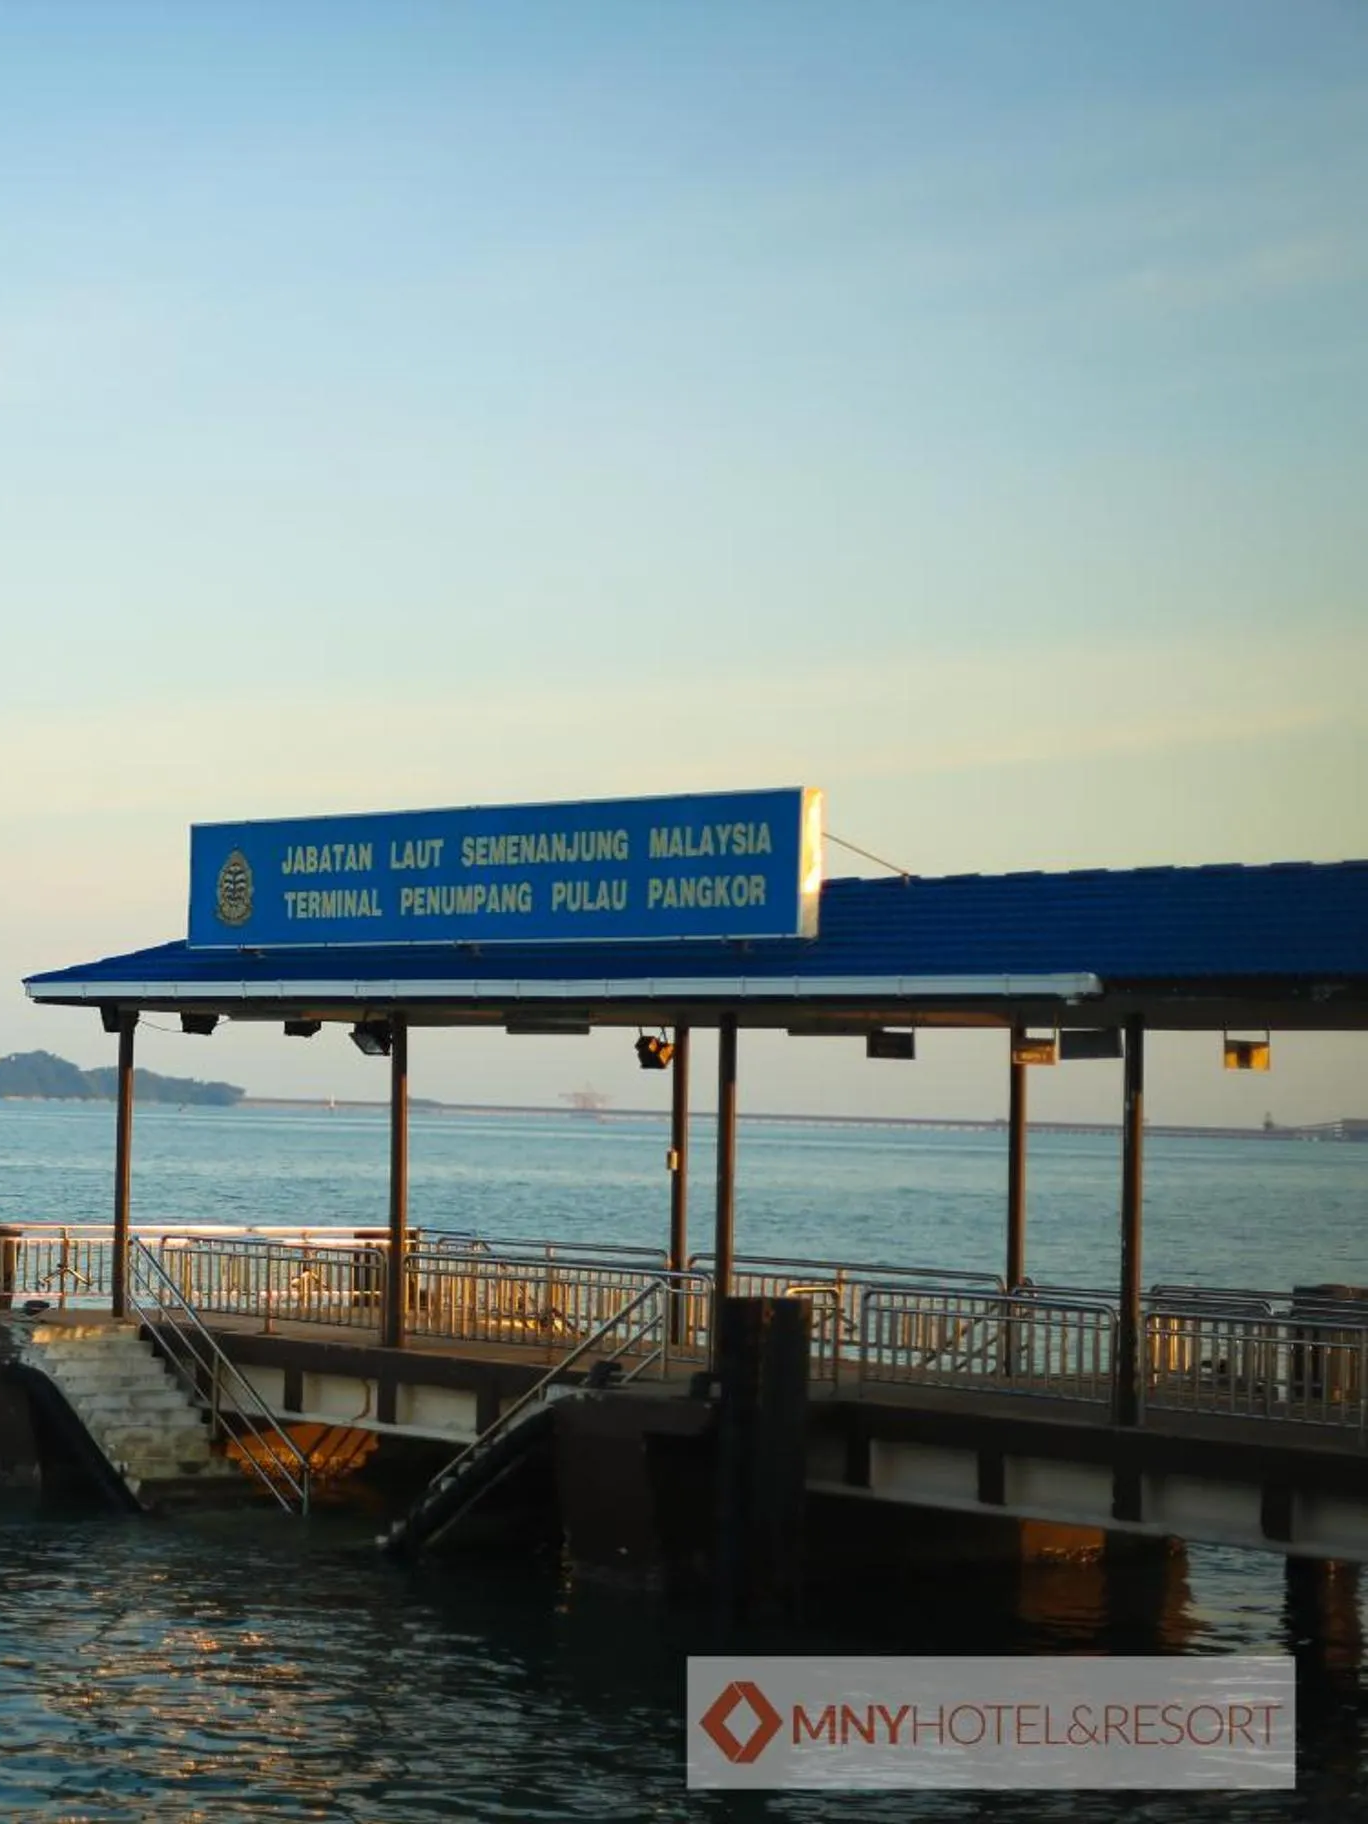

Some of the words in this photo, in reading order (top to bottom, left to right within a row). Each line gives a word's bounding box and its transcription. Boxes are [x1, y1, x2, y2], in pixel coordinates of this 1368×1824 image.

[282, 843, 373, 875] JABATAN
[390, 839, 444, 870] LAUT
[461, 830, 629, 866] SEMENANJUNG
[649, 822, 772, 857] MALAYSIA
[284, 888, 383, 920] TERMINAL
[400, 882, 532, 916] PENUMPANG
[552, 878, 628, 912] PULAU
[647, 875, 767, 909] PANGKOR
